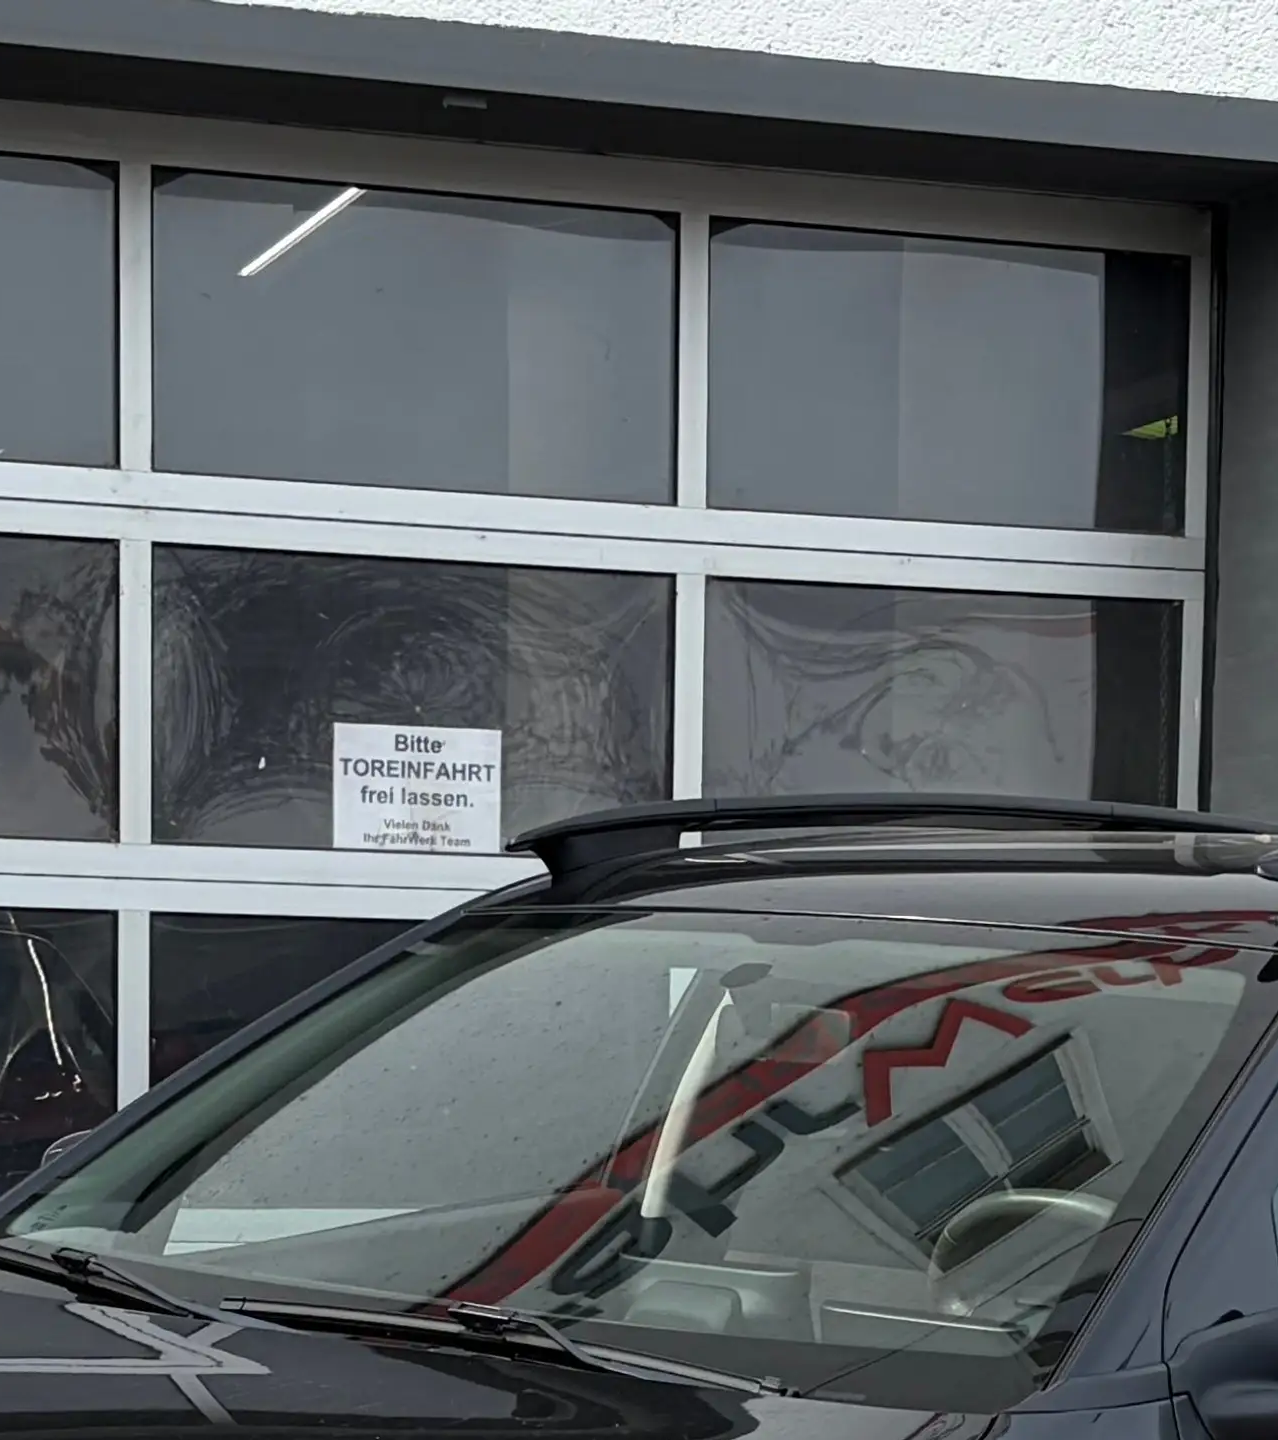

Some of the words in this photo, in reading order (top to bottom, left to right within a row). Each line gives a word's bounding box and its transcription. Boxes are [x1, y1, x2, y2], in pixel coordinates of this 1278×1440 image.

[394, 733, 443, 754] Bitte
[339, 757, 496, 782] TOREINFAHRT
[360, 785, 394, 805] frei
[401, 787, 475, 808] lassen.
[383, 818, 419, 830] Vielen
[422, 820, 451, 831] Dank
[440, 834, 471, 847] Team
